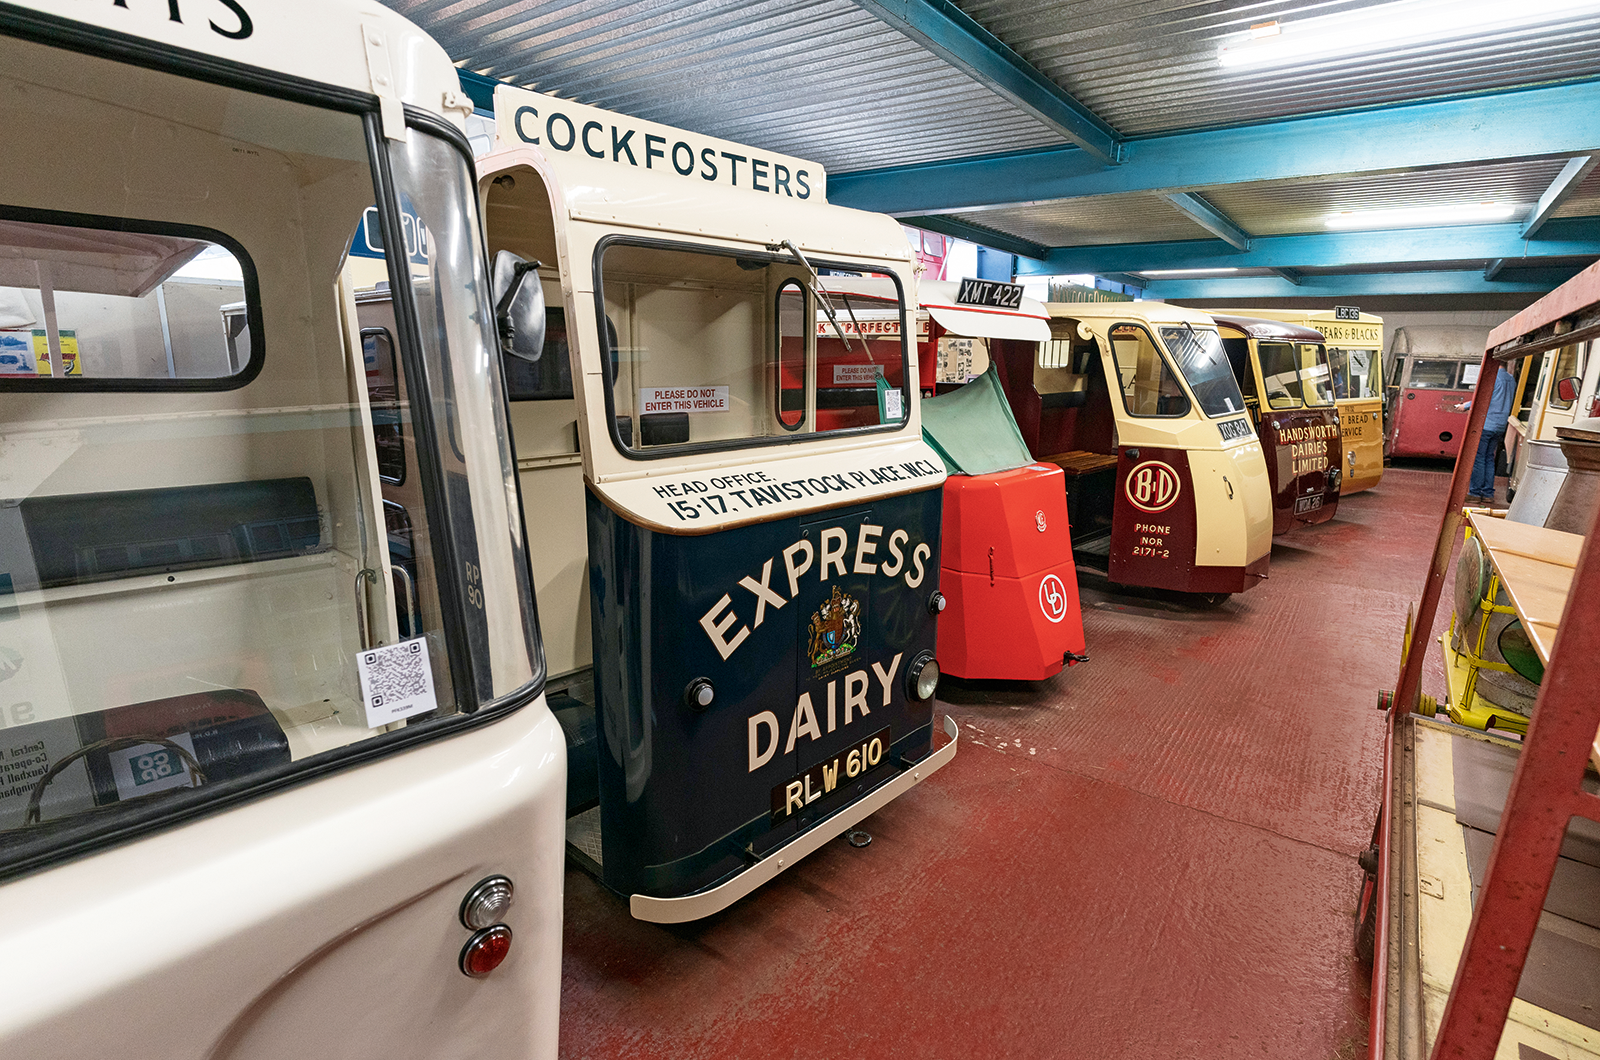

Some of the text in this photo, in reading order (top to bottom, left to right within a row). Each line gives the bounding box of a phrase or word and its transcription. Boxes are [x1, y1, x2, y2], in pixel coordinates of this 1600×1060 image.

[514, 105, 811, 200] COCKFOSTERS
[960, 281, 1021, 307] XMT 422
[1344, 329, 1350, 339] &
[1351, 328, 1379, 341] BLACKS
[654, 388, 716, 399] PLEASE DO NOT
[645, 399, 724, 411] ENTER THIS VEHICLE
[1218, 419, 1250, 440] XOG 847
[1347, 414, 1369, 425] BREAD
[1279, 424, 1338, 445] HANDSWORTH
[1291, 440, 1328, 460] DAIRIES
[1292, 456, 1329, 475] LIMITED
[652, 471, 777, 499] HEAD OFFICE.
[728, 472, 856, 509] TAVISTOCK
[1134, 523, 1171, 535] PHONE
[1140, 536, 1163, 547] NOR
[1132, 546, 1170, 559] 2171-2
[465, 561, 480, 585] RP
[467, 584, 483, 610] 90
[699, 523, 931, 662] EXPRESS
[747, 651, 904, 773] DAIRY
[785, 737, 883, 816] RLW 610
